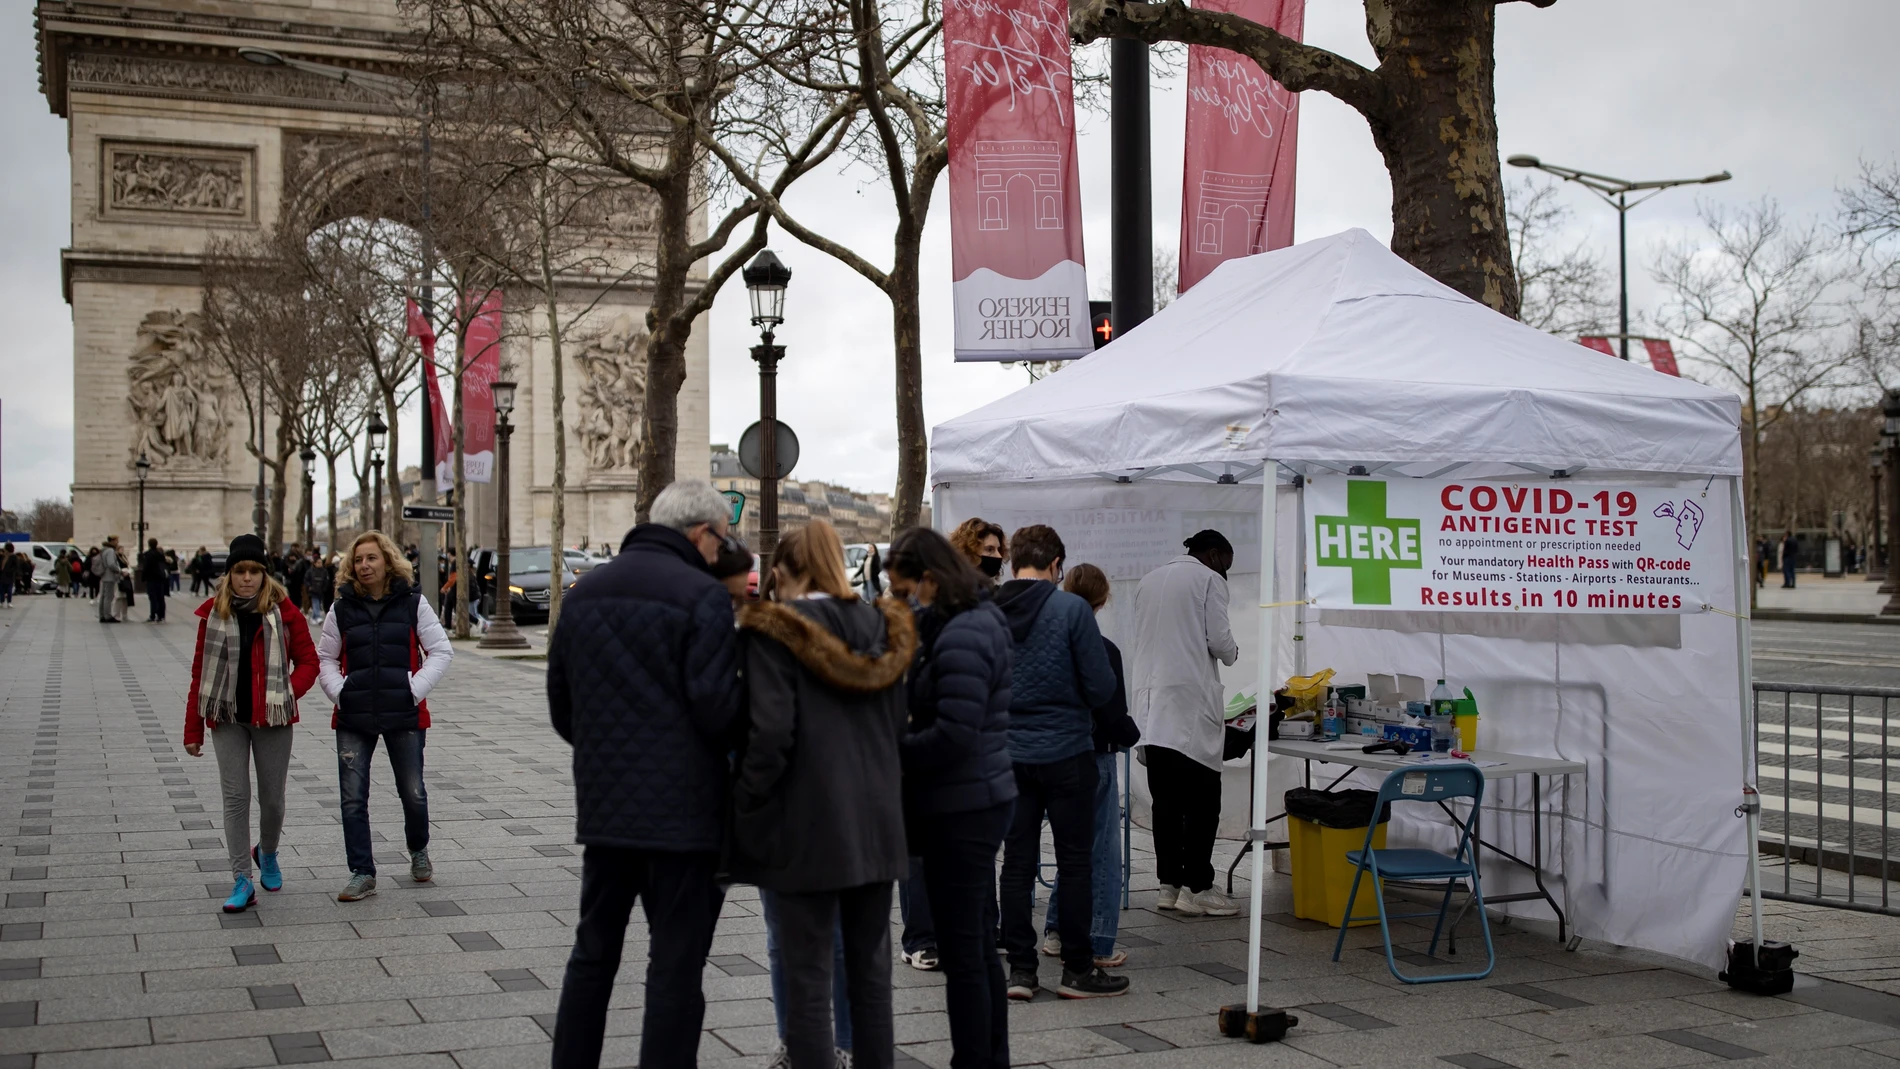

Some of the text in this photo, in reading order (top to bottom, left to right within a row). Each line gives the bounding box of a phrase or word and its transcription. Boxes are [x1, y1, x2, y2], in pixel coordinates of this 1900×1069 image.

[1440, 484, 1637, 517] COVID-19
[1440, 515, 1638, 537] ANTIGENIC TEST
[1319, 524, 1418, 561] HERE
[1439, 537, 1641, 553] no appointment or prescription needed
[1439, 554, 1691, 573] Your mandatory Health Pass with QR-code
[1432, 569, 1449, 581] for
[1452, 570, 1506, 582] Museums
[1516, 571, 1562, 583] Stations
[1571, 572, 1617, 586] Airports
[1626, 574, 1700, 586] Restaurants...
[1421, 586, 1682, 609] Results in 10 minutes
